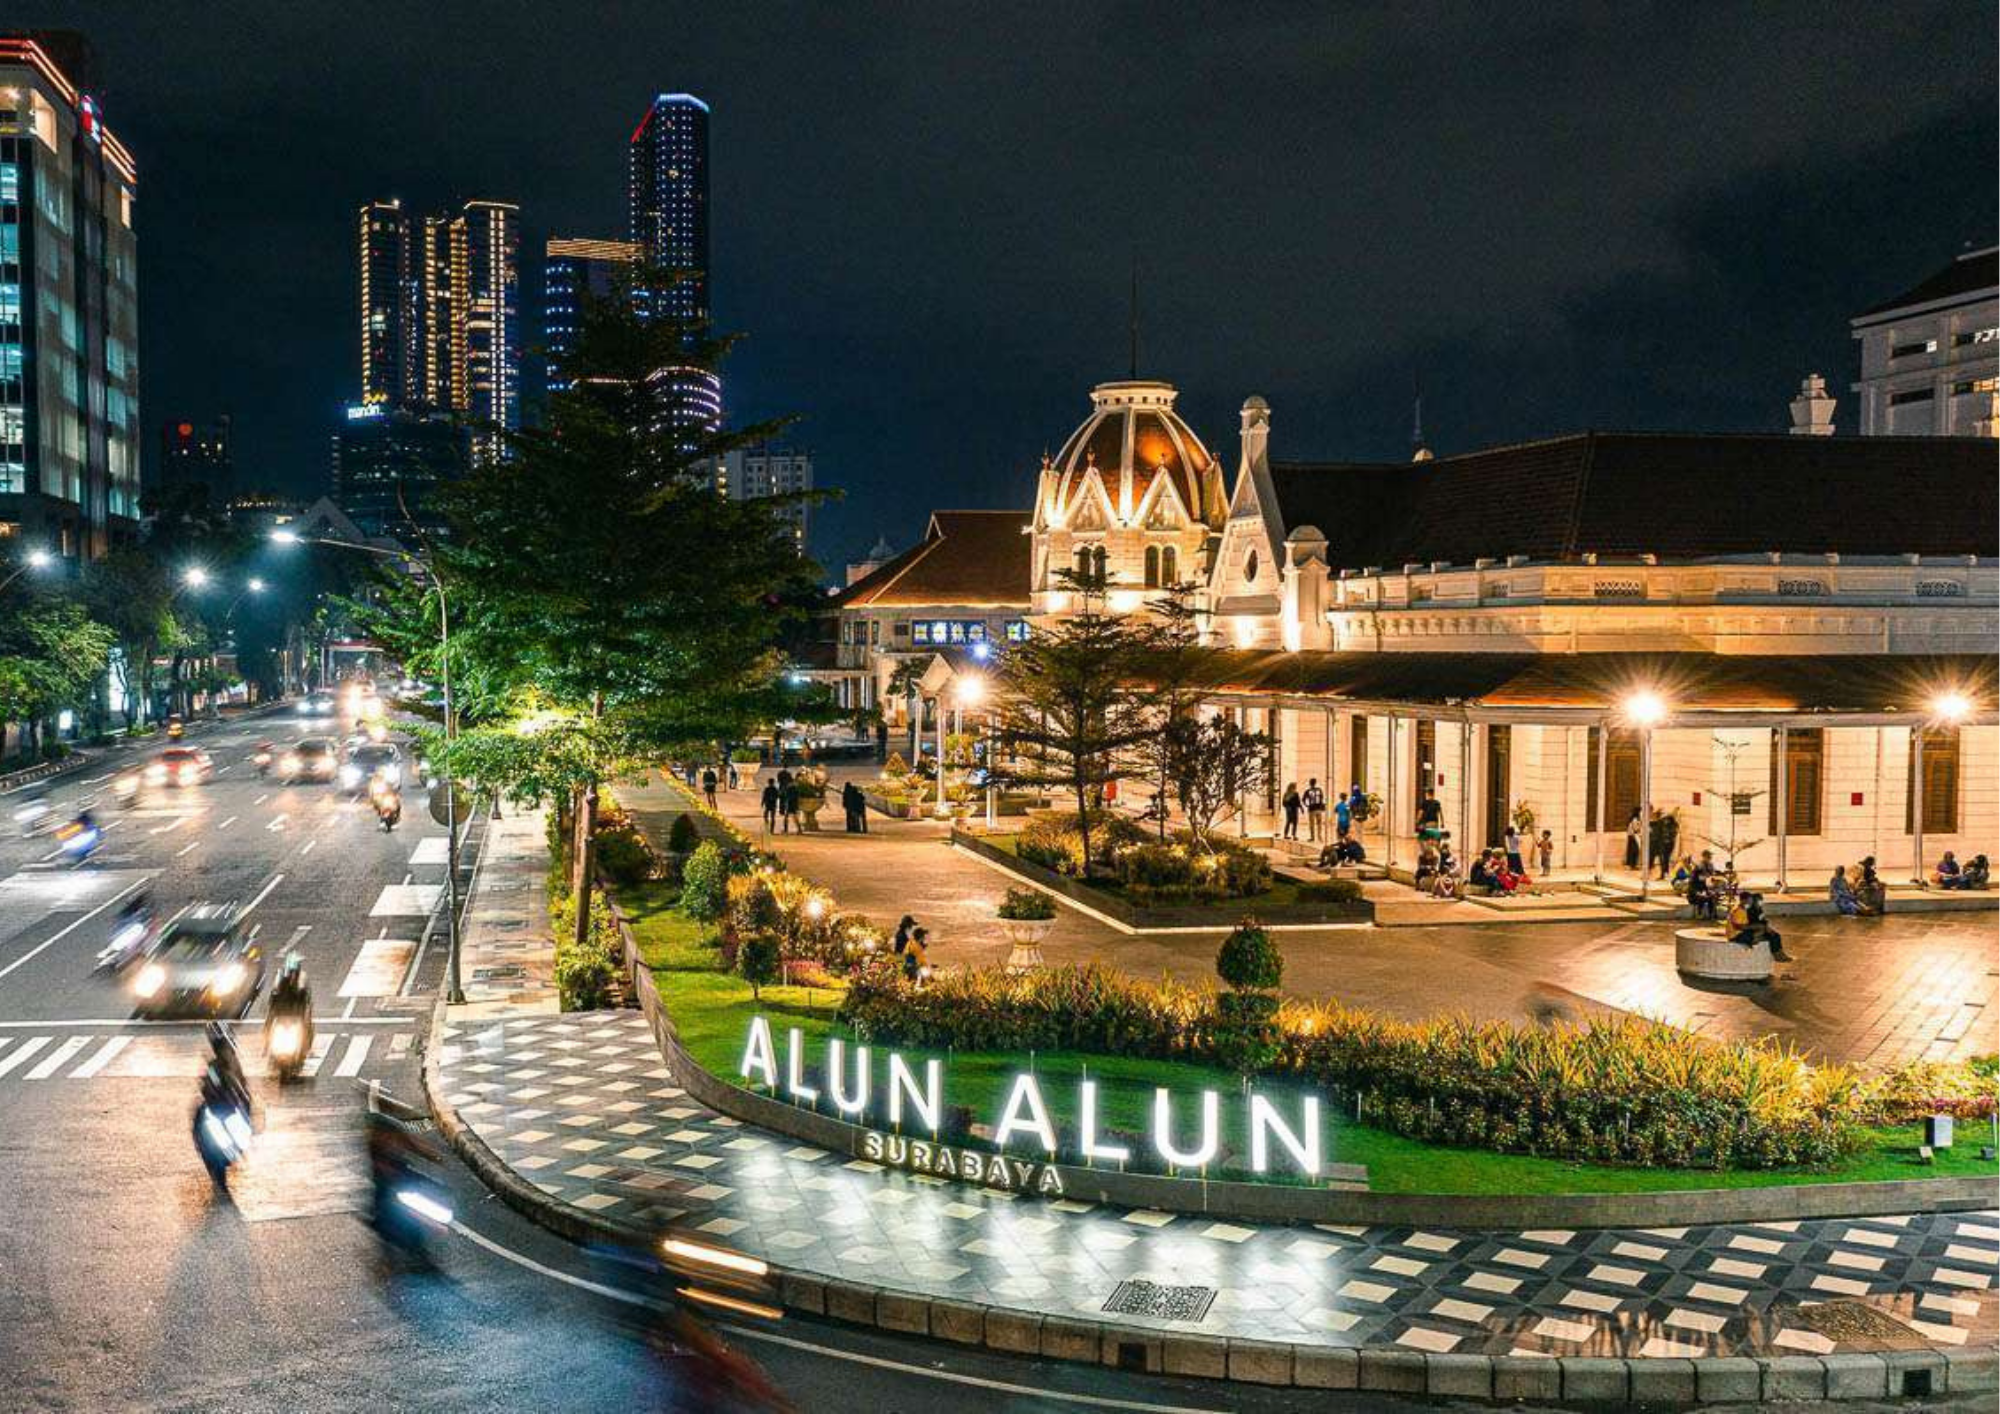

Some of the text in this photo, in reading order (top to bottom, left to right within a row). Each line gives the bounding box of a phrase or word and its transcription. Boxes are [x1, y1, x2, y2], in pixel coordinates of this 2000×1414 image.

[741, 1016, 1319, 1174] ALUN ALUN
[864, 1132, 1064, 1194] SURABAYA
